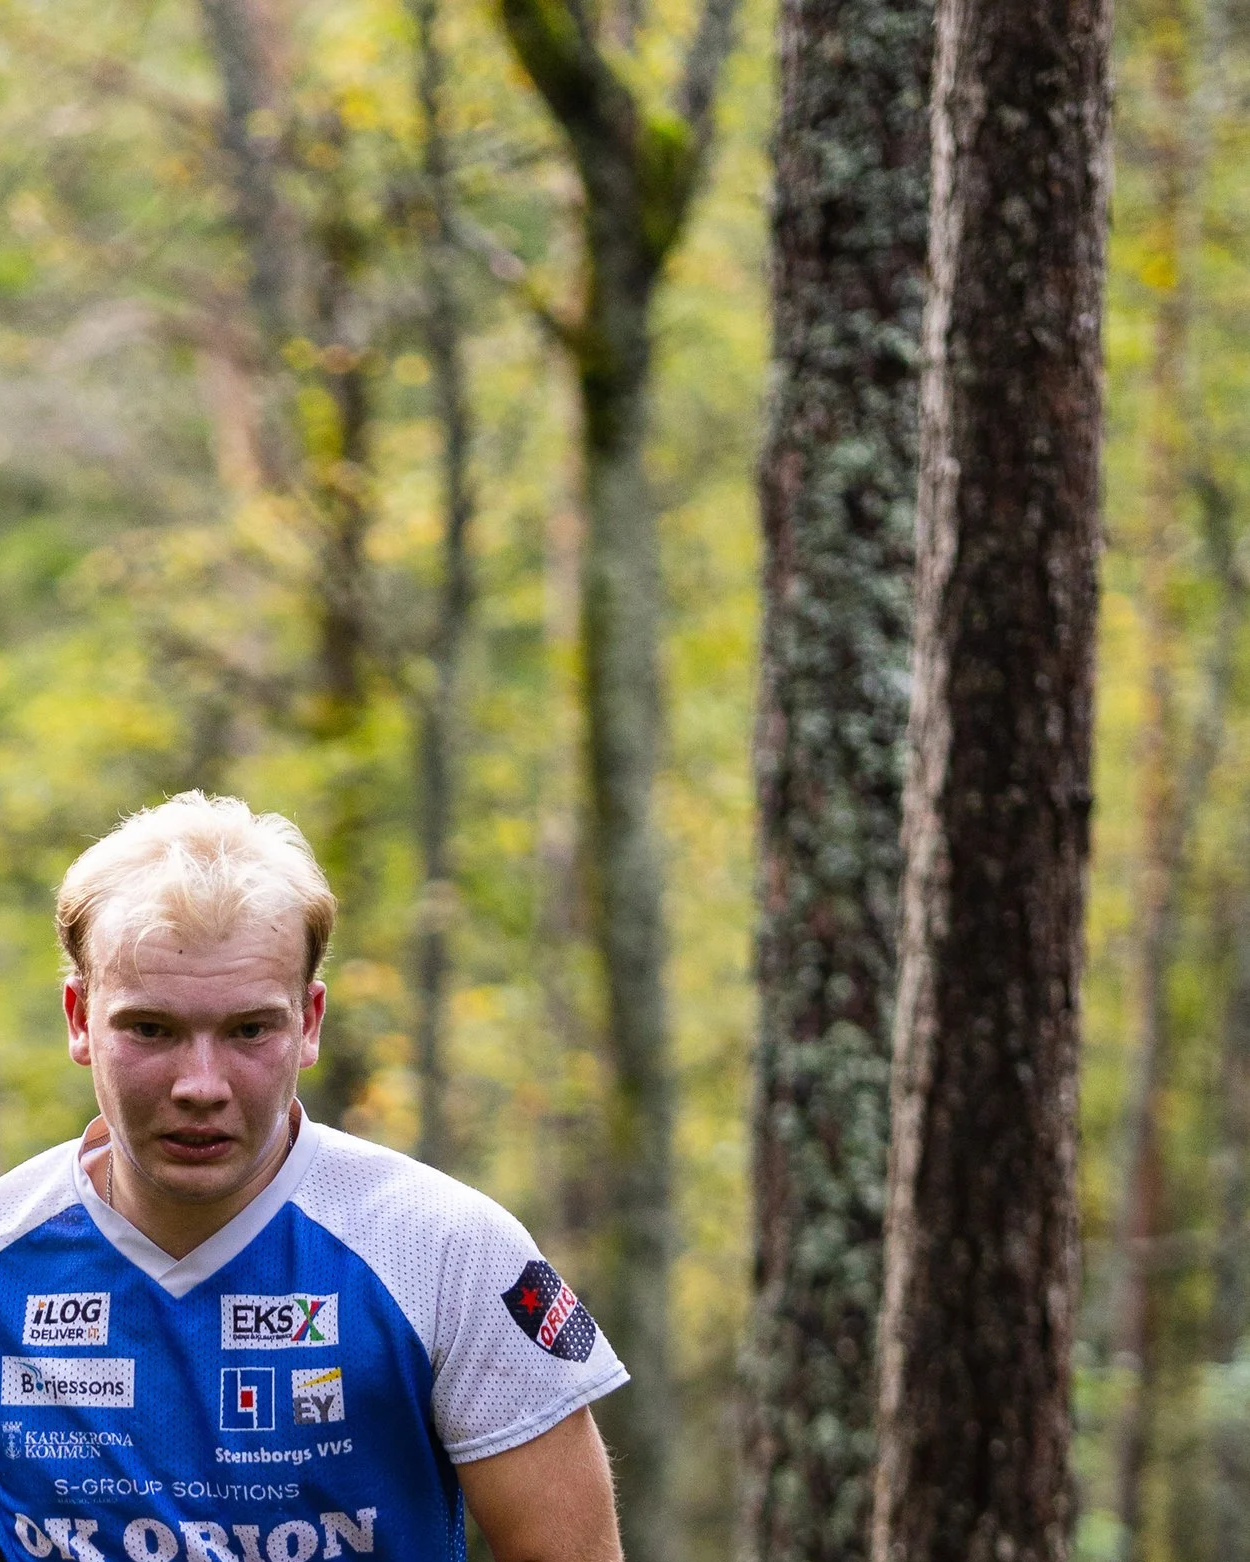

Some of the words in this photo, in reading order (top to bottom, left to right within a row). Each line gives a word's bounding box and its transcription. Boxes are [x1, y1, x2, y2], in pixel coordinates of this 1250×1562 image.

[30, 1328, 84, 1340] DELIVER
[294, 1394, 336, 1424] EY
[25, 1431, 134, 1446] KARLSKRONA
[25, 1445, 101, 1459] KOMMUN
[215, 1447, 312, 1466] Stensborgs
[317, 1438, 353, 1457] VVS
[54, 1478, 163, 1495] S-GROUP
[172, 1481, 300, 1500] SOLUTIONS
